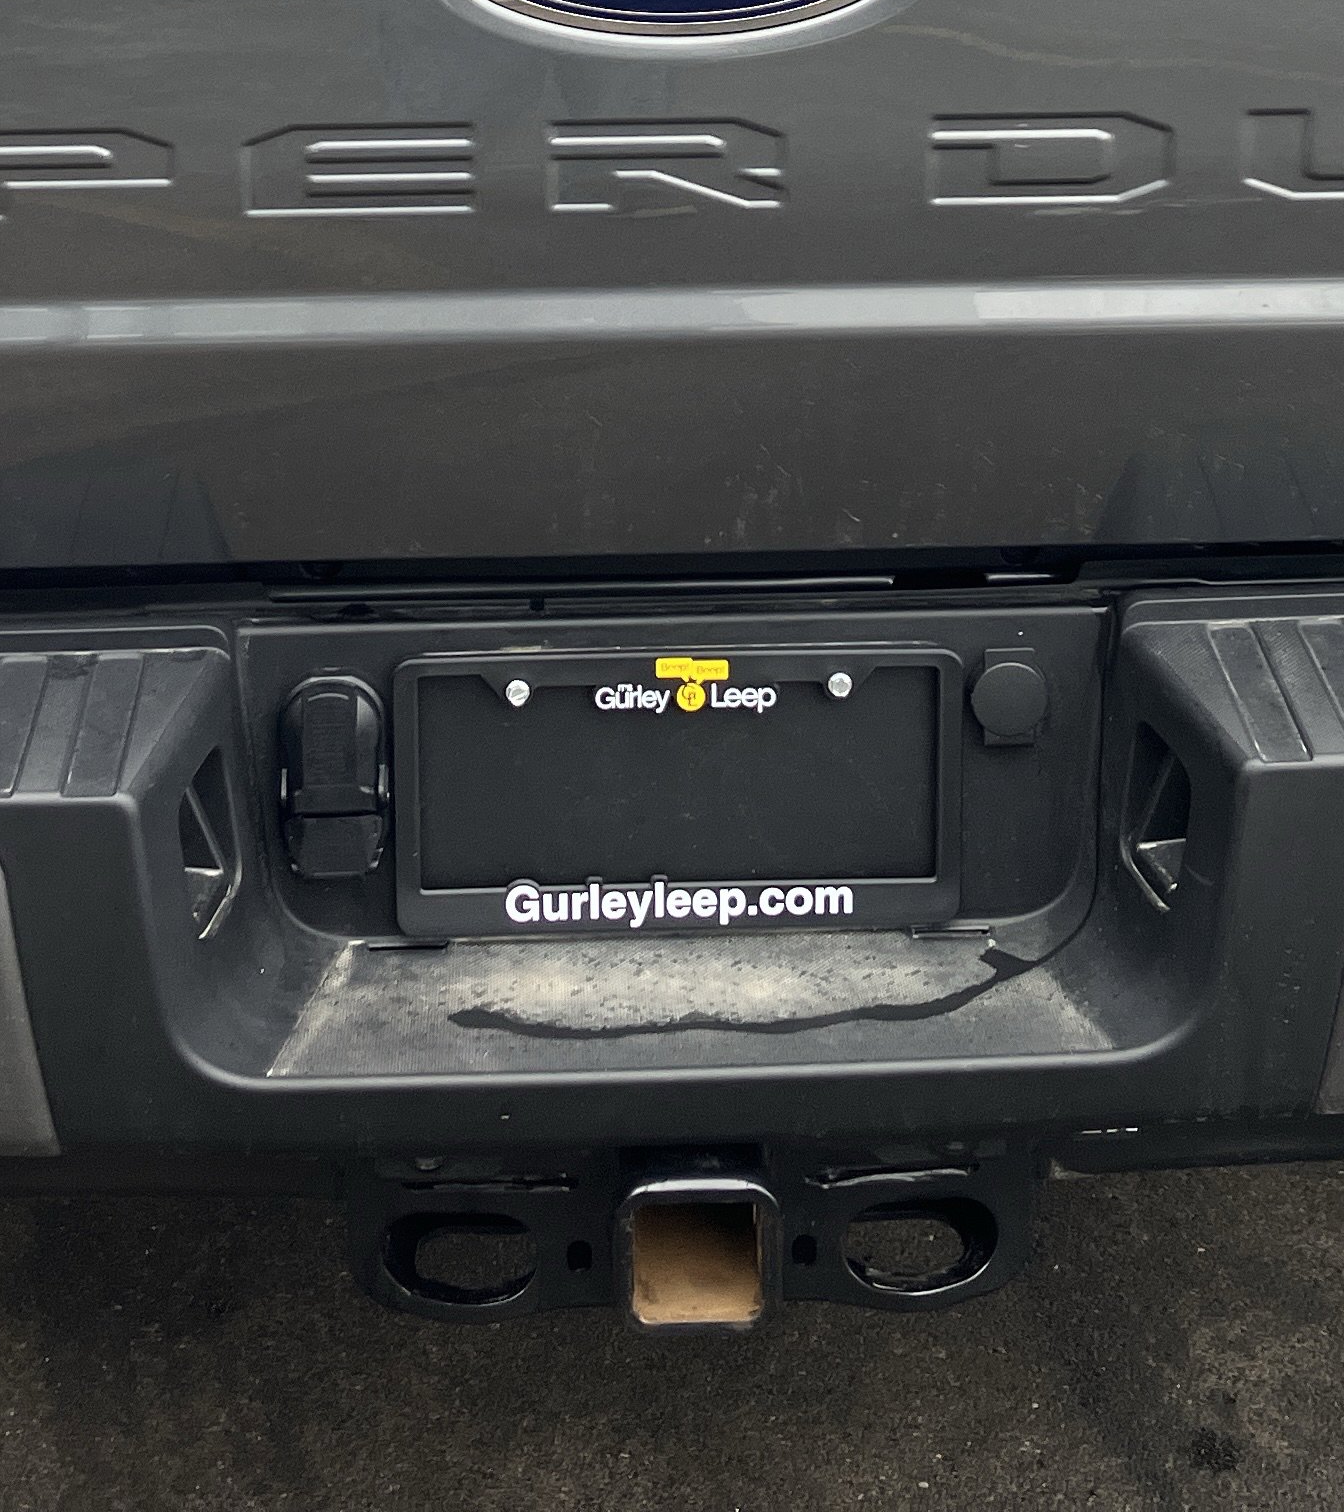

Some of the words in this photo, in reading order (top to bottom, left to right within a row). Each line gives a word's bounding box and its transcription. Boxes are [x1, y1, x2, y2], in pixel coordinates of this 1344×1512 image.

[595, 684, 671, 714] Gurley
[711, 682, 777, 714] Leep
[505, 881, 854, 928] Gurleyleep.com
